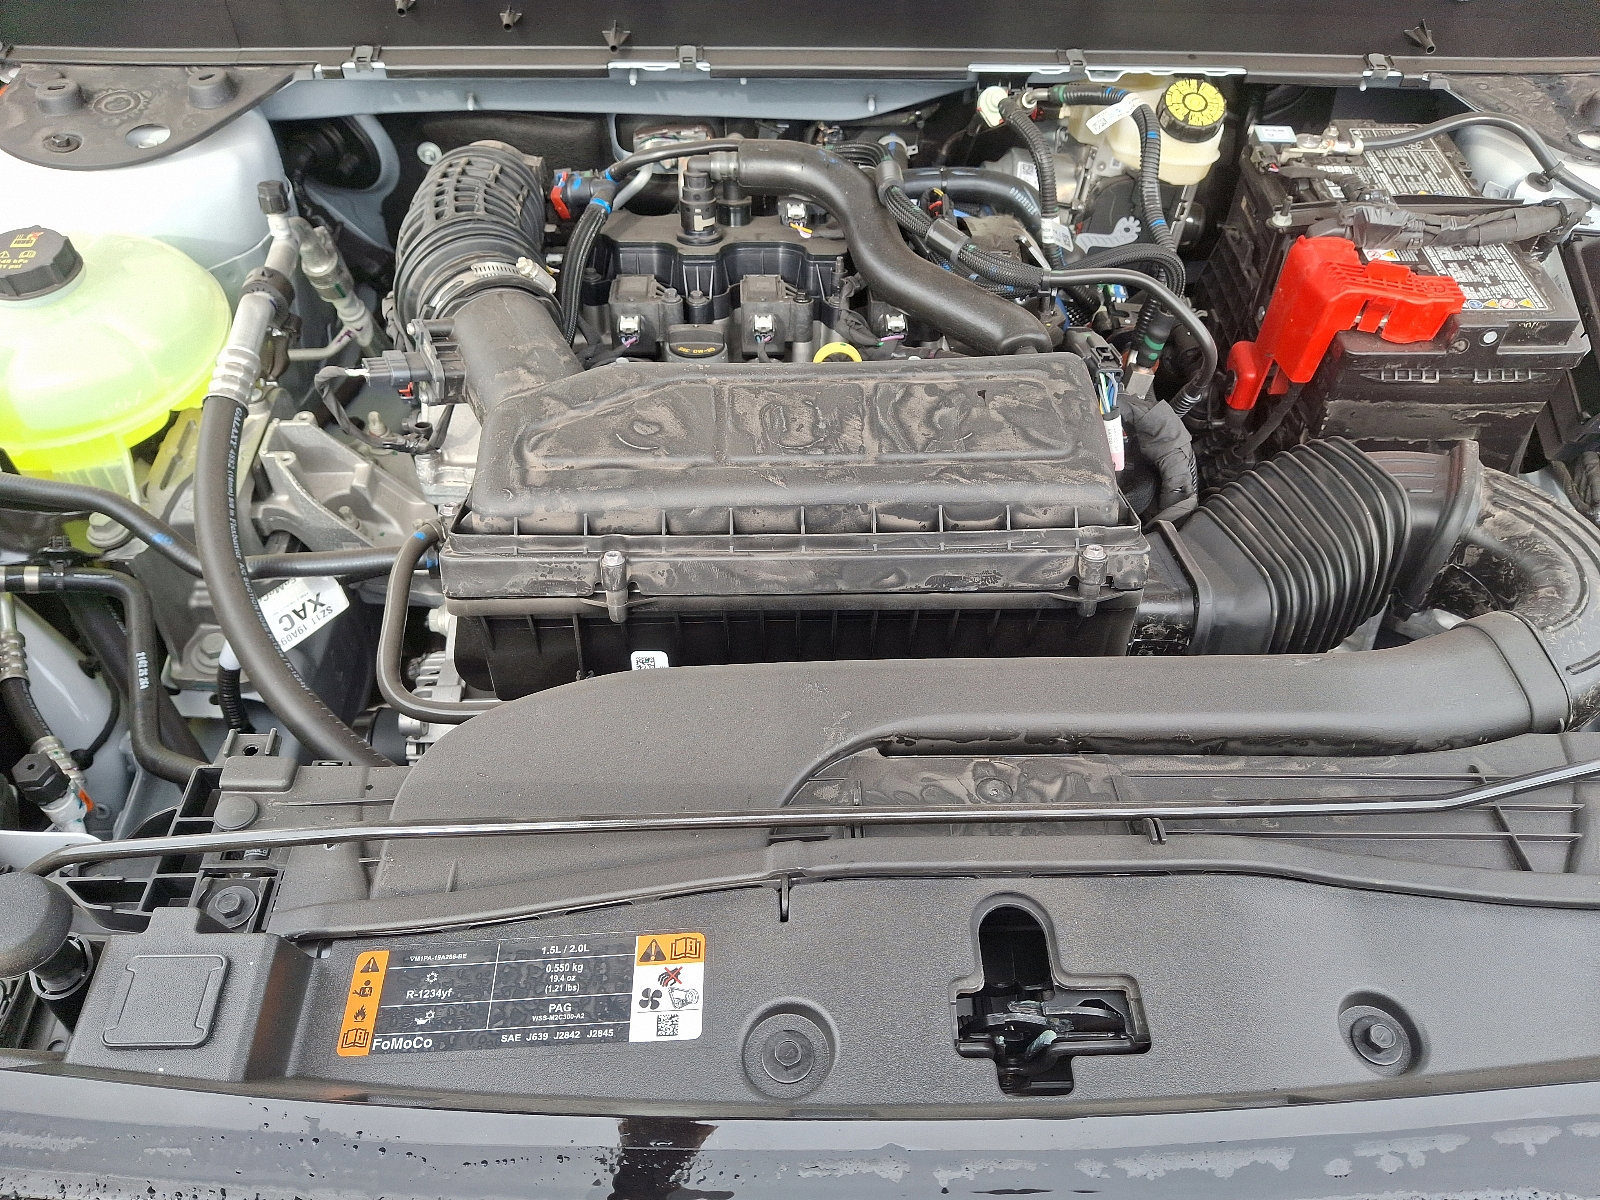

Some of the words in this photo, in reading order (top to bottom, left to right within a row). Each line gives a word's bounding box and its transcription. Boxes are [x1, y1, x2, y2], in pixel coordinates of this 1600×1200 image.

[229, 407, 243, 449] GALAXY
[229, 517, 242, 560] Flexbarrier
[278, 592, 326, 632] XAC
[278, 623, 308, 647] 19A09
[541, 945, 562, 955] 1.5L
[569, 943, 590, 953] 2.0L
[545, 963, 570, 973] 0.550
[571, 962, 584, 973] kg
[549, 974, 566, 983] 19.4
[566, 974, 576, 982] oz
[405, 987, 454, 1000] R-1234yf
[544, 985, 564, 994] (1.21
[565, 984, 581, 993] lbs)
[548, 1003, 572, 1014] PAG
[500, 1034, 522, 1043] SAE
[525, 1032, 549, 1042] J639
[553, 1030, 581, 1041] J2842
[586, 1029, 614, 1039] J2845
[371, 1036, 433, 1051] FoMoCo
